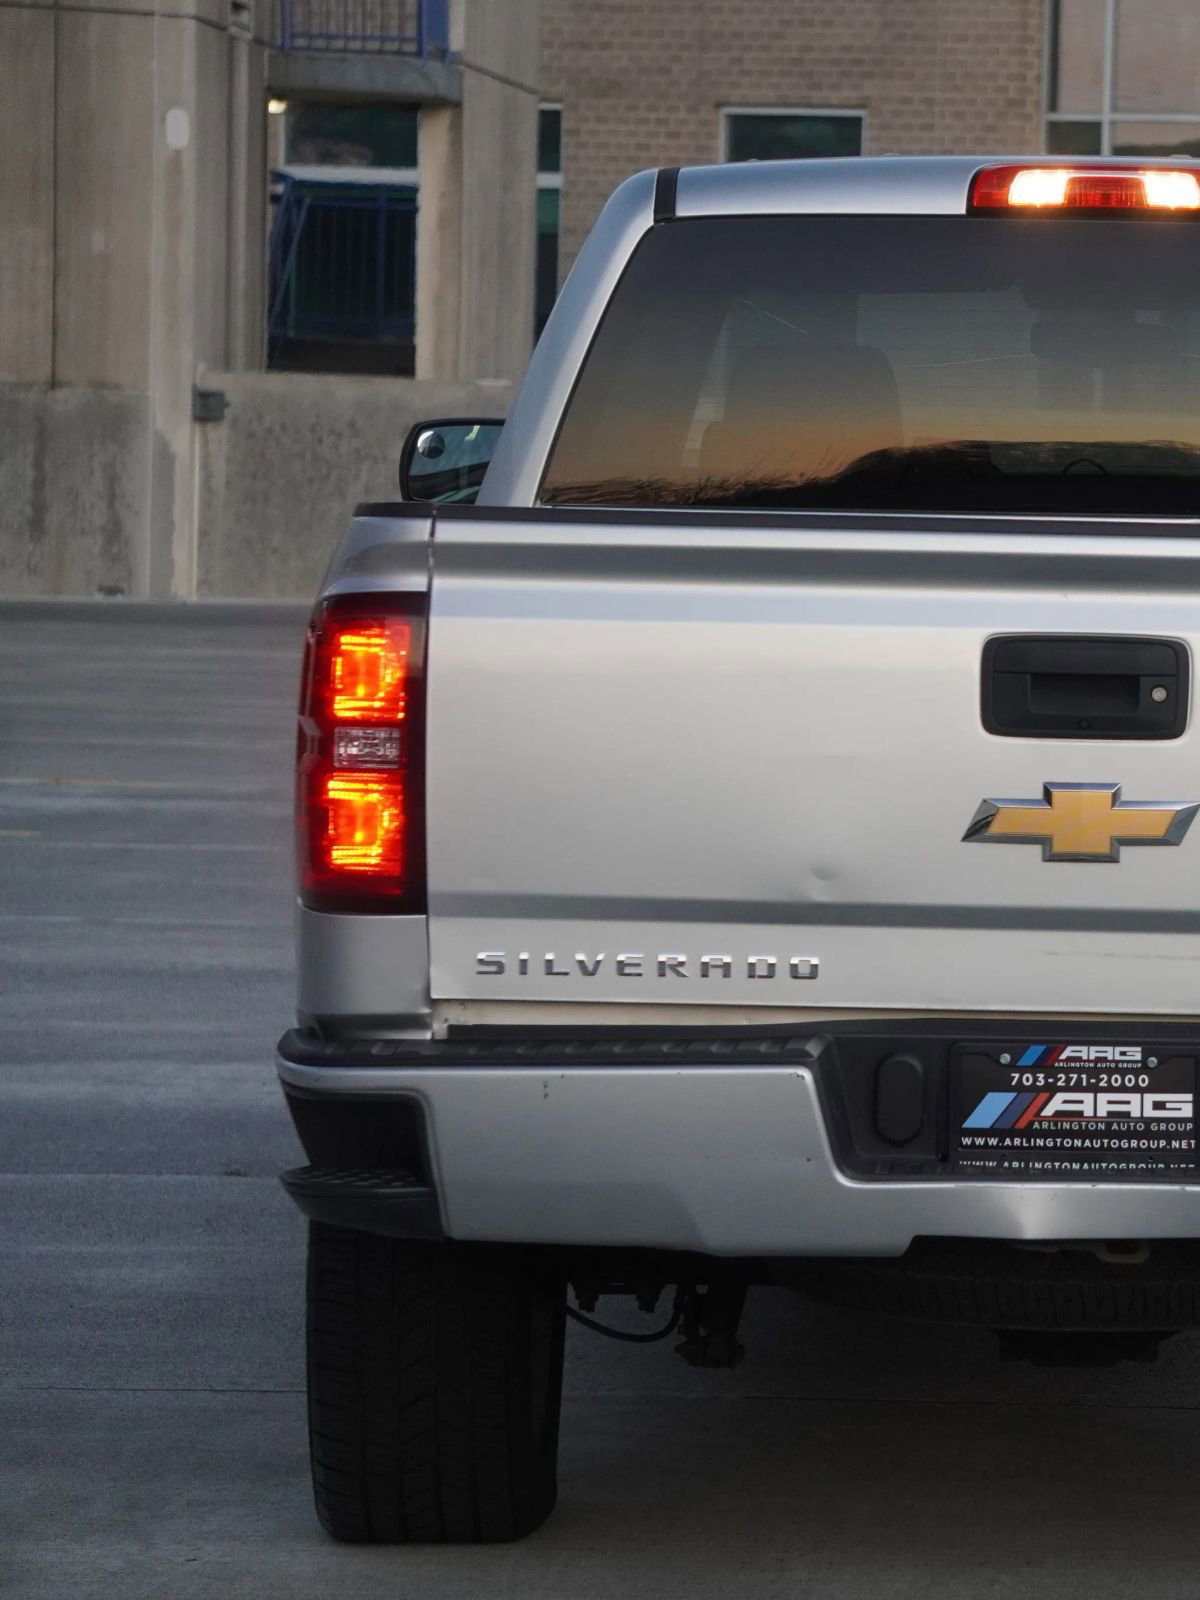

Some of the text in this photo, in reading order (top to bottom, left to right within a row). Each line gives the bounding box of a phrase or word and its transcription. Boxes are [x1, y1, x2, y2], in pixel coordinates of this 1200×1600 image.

[475, 951, 820, 980] SILVERADO
[1058, 1046, 1142, 1060] AAG
[1011, 1073, 1149, 1087] 703-271-2000
[1039, 1092, 1193, 1118] AAG
[1032, 1121, 1193, 1132] ARLINGTON AUTO GROUP
[961, 1136, 1196, 1149] WWW.ARLINGTONAUTOGROUP.NET
